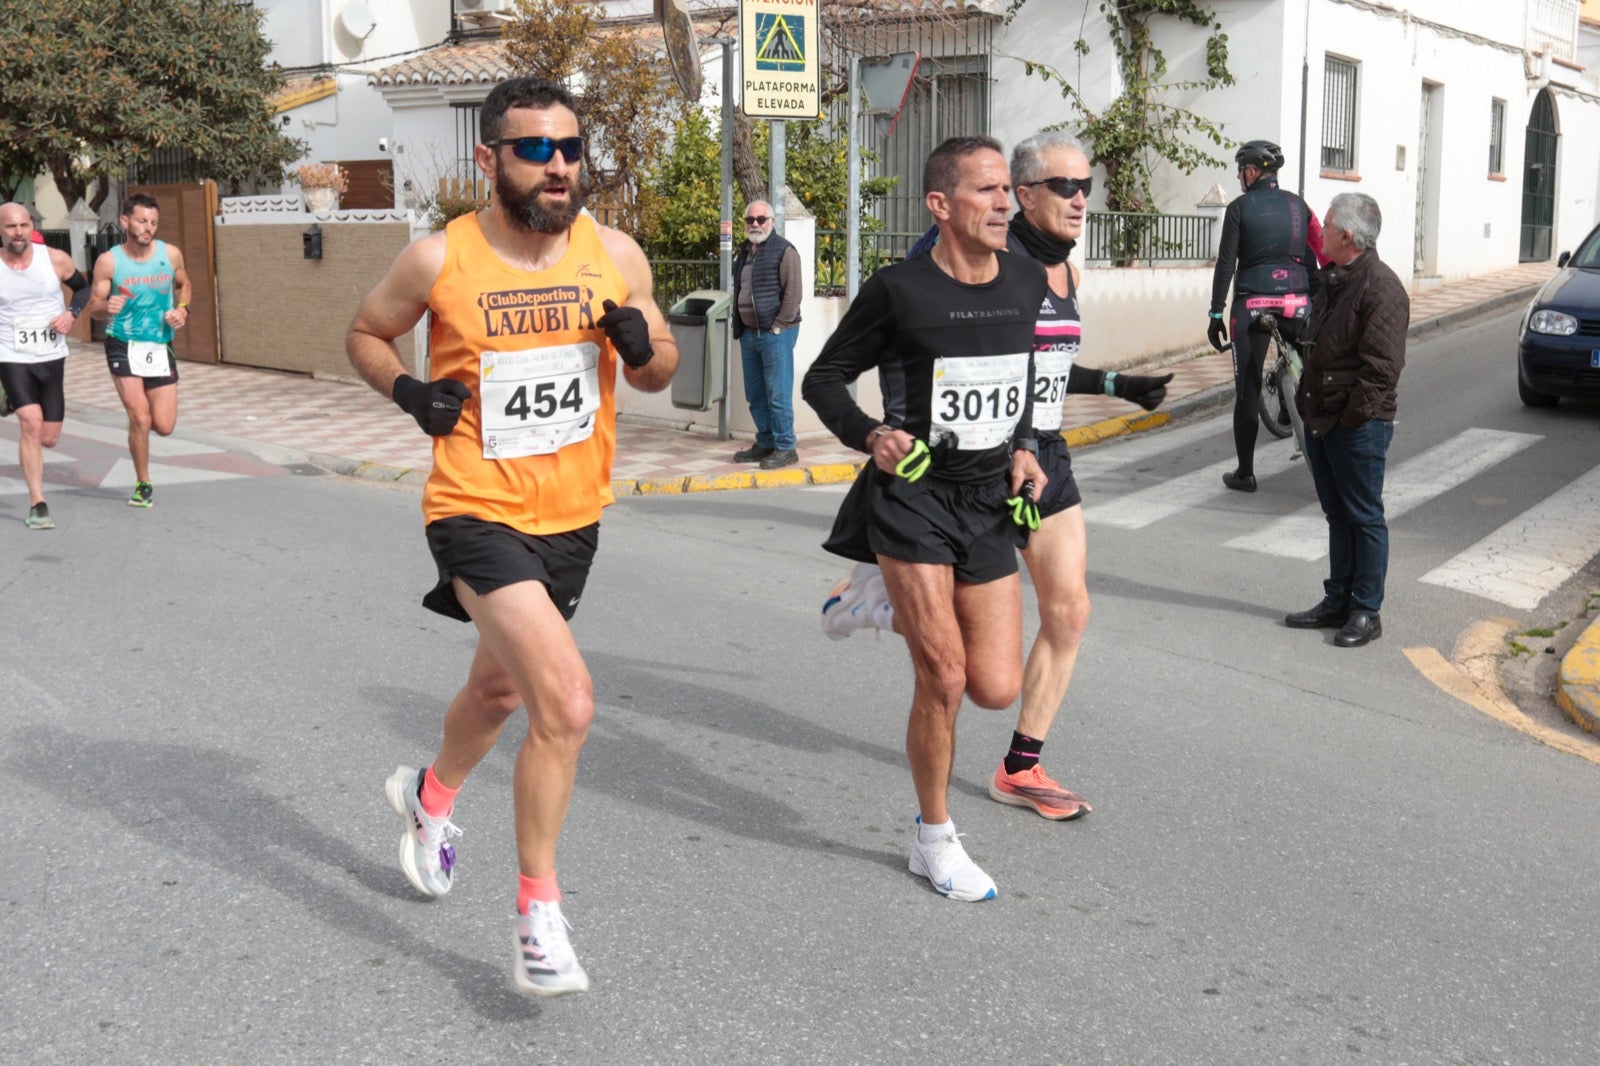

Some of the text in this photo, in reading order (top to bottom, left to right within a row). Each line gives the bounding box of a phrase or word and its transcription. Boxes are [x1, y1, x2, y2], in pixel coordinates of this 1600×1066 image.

[746, 81, 816, 93] PLATAFORMA
[757, 98, 805, 109] ELEVADA
[488, 288, 577, 307] ClubDeportivo
[19, 330, 57, 344] 3116
[146, 351, 153, 364] 6
[504, 377, 583, 421] 454
[940, 386, 1019, 422] 3018
